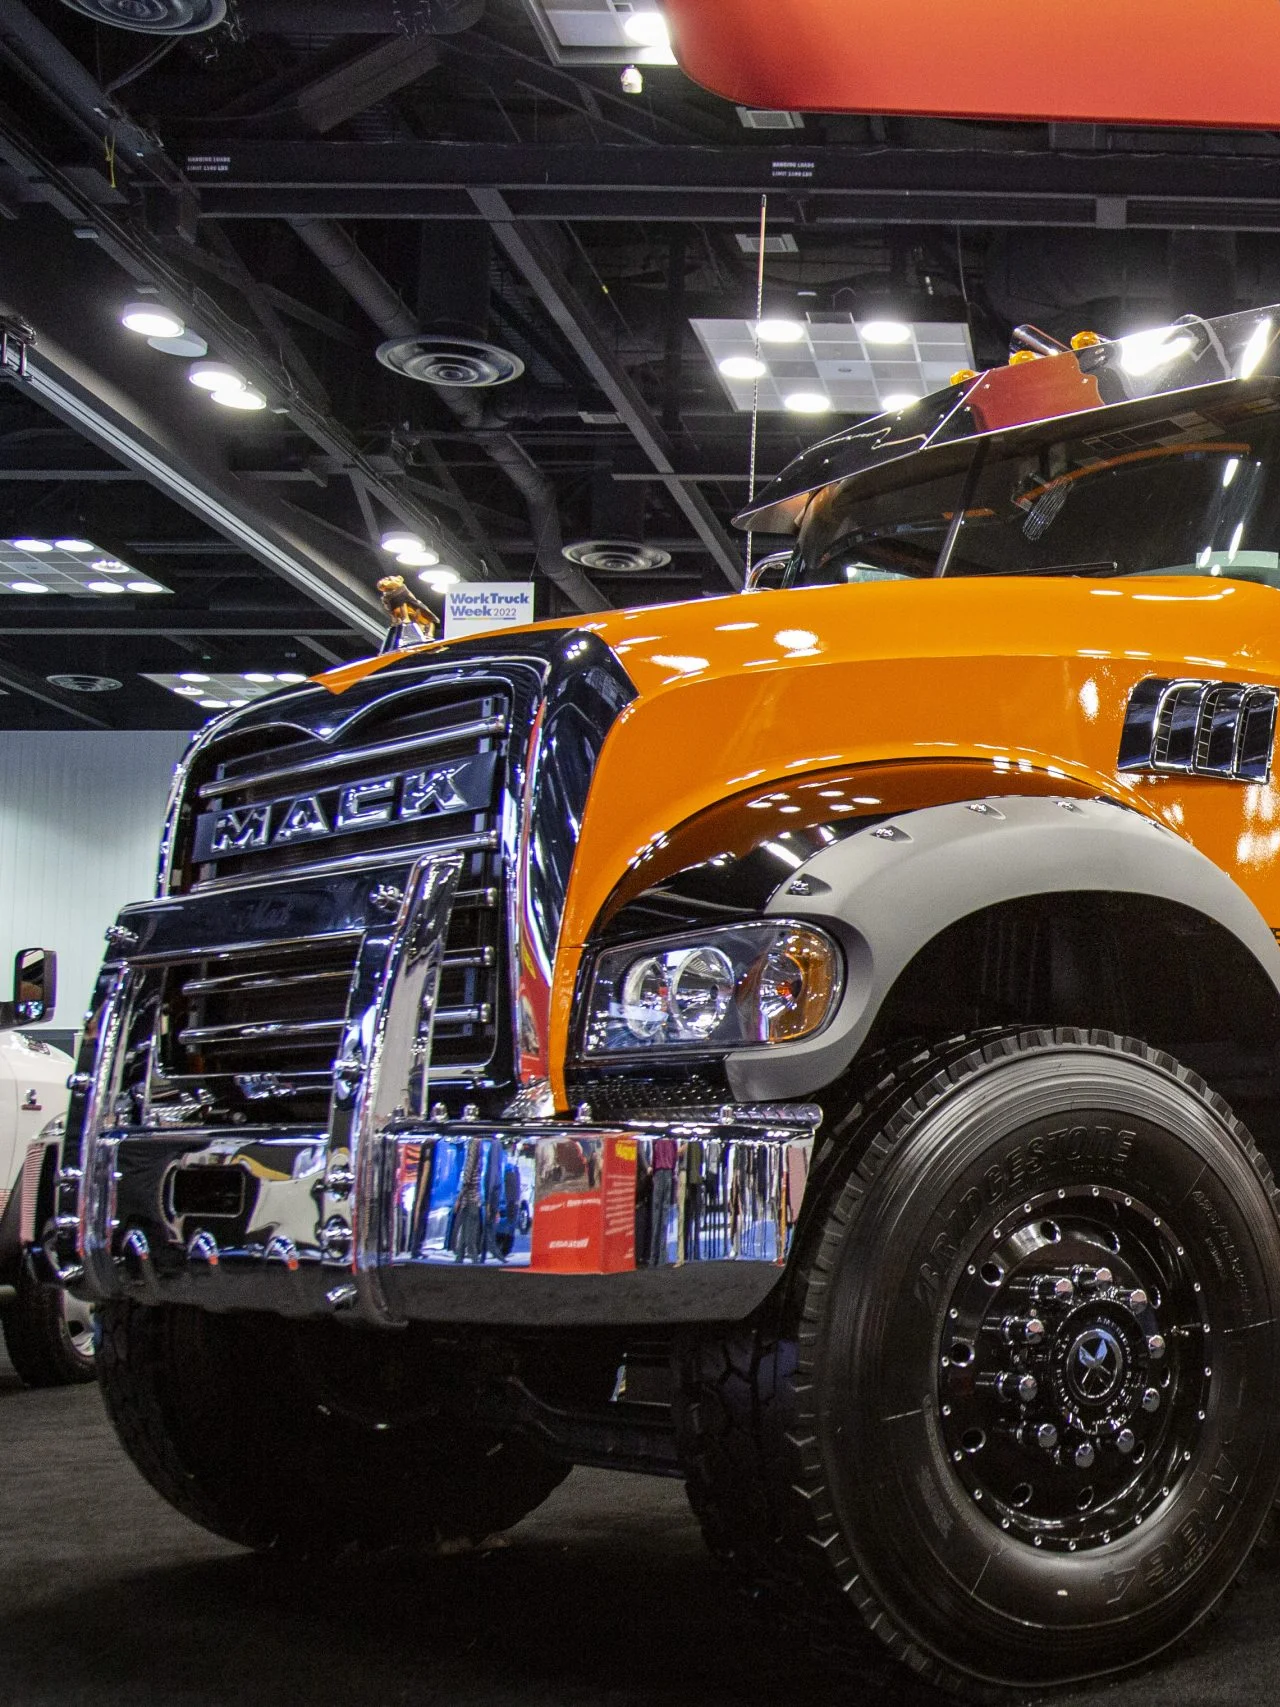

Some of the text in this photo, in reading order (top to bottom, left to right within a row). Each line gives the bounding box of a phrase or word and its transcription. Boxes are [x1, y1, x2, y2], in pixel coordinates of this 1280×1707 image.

[450, 605, 517, 617] Week 2022
[212, 762, 470, 852] MACK
